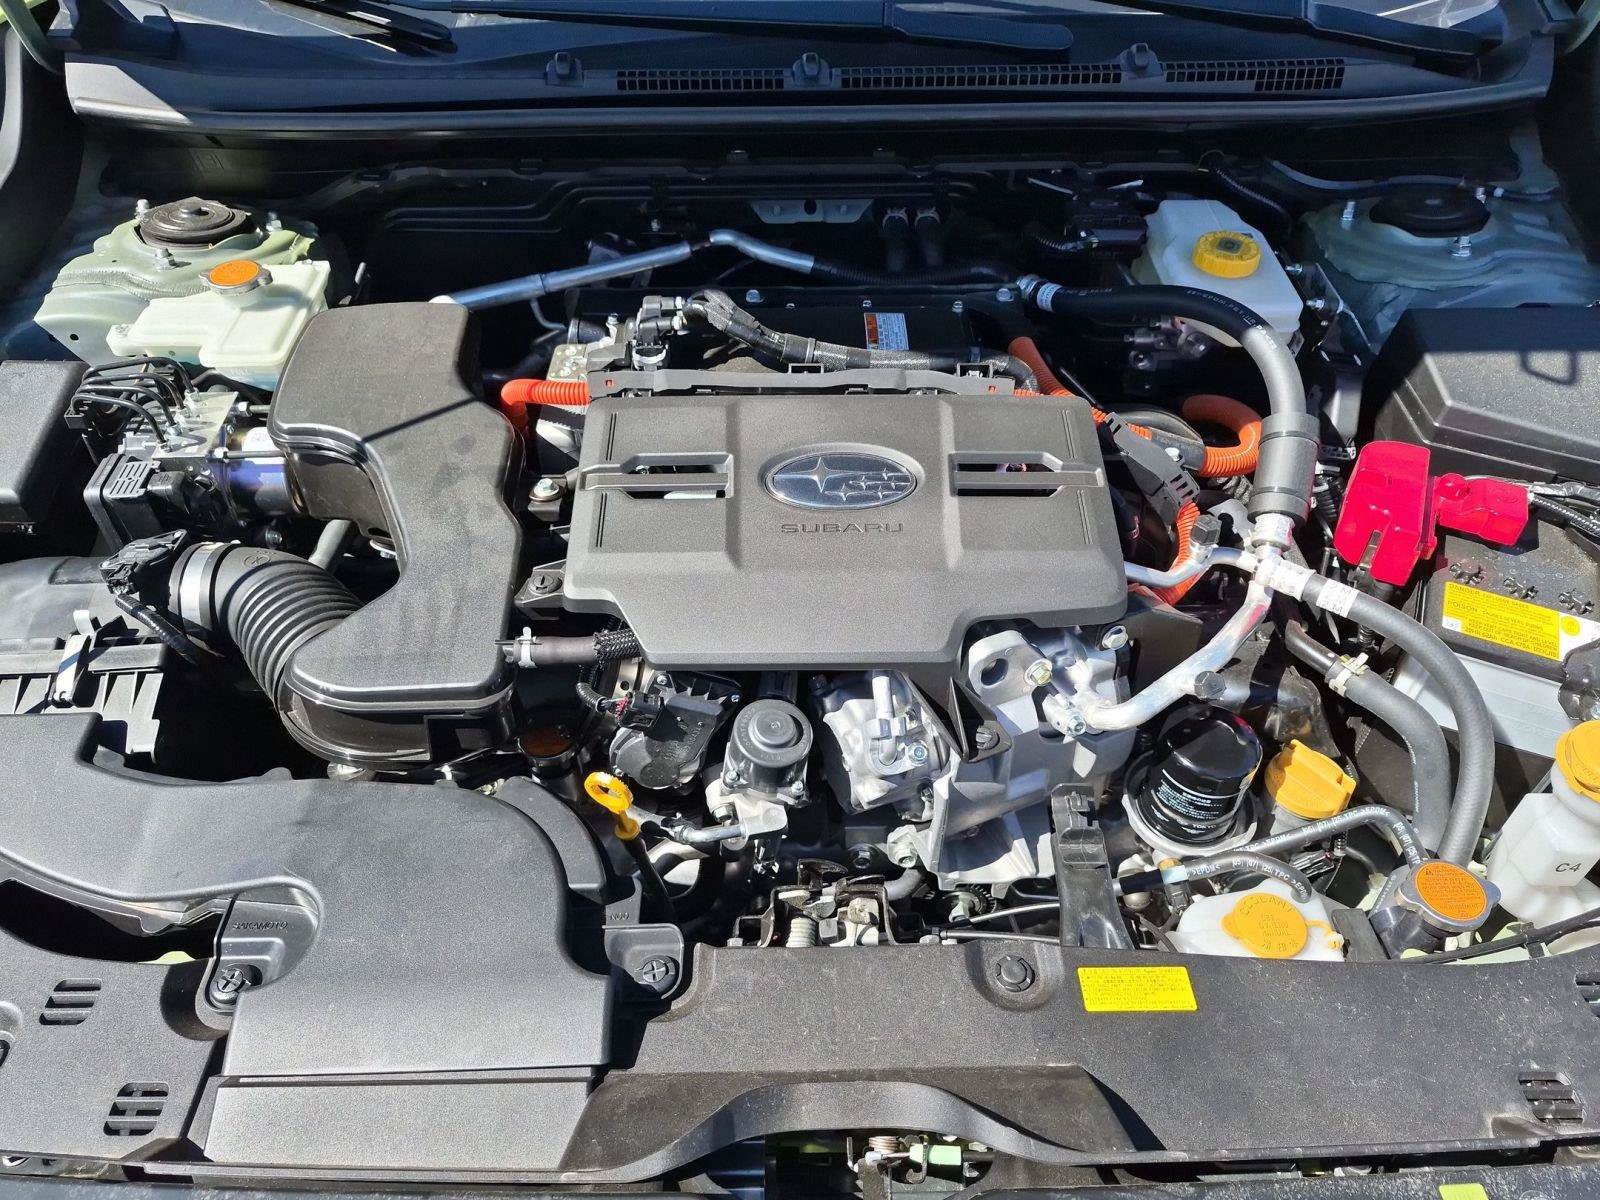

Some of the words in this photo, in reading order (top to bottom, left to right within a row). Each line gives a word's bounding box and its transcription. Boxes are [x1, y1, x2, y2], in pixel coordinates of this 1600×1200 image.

[781, 523, 904, 533] SUBARU
[1448, 583, 1481, 596] DANGER
[1447, 600, 1478, 613] POISON
[1555, 862, 1582, 873] C4
[1274, 868, 1291, 881] TPC
[1240, 895, 1293, 916] COOLANT
